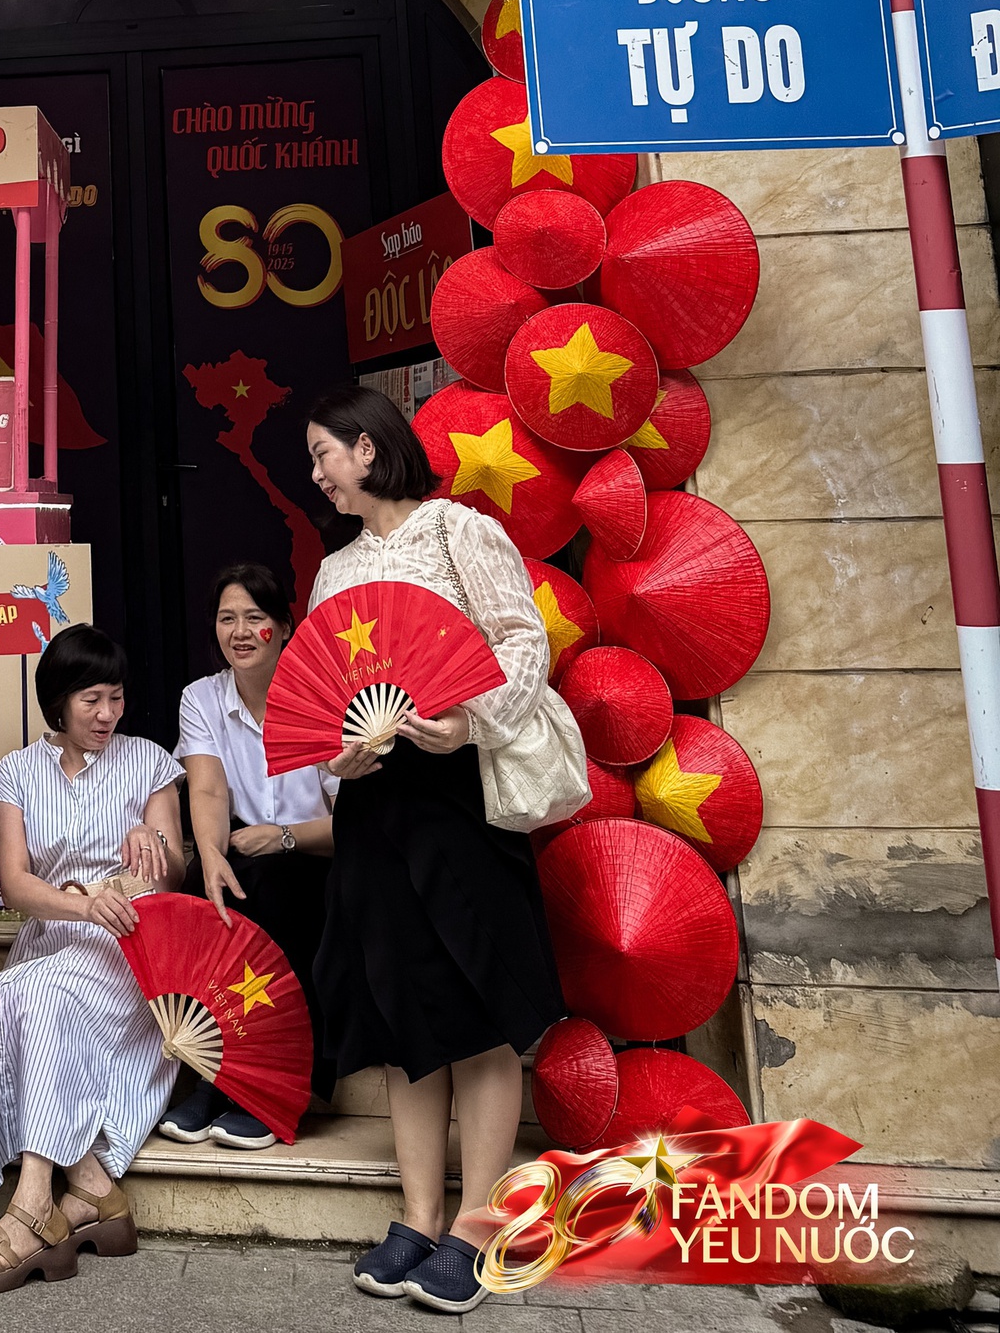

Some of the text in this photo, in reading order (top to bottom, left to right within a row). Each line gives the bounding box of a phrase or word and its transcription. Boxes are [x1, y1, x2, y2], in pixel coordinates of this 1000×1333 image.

[617, 20, 806, 123] TỰ DO
[197, 202, 345, 309] 80
[267, 257, 295, 270] 2025
[381, 221, 422, 258] Sạp báo
[363, 270, 416, 342] ĐỘC
[341, 657, 393, 685] VIET NAM
[208, 979, 248, 1039] VIET NAM
